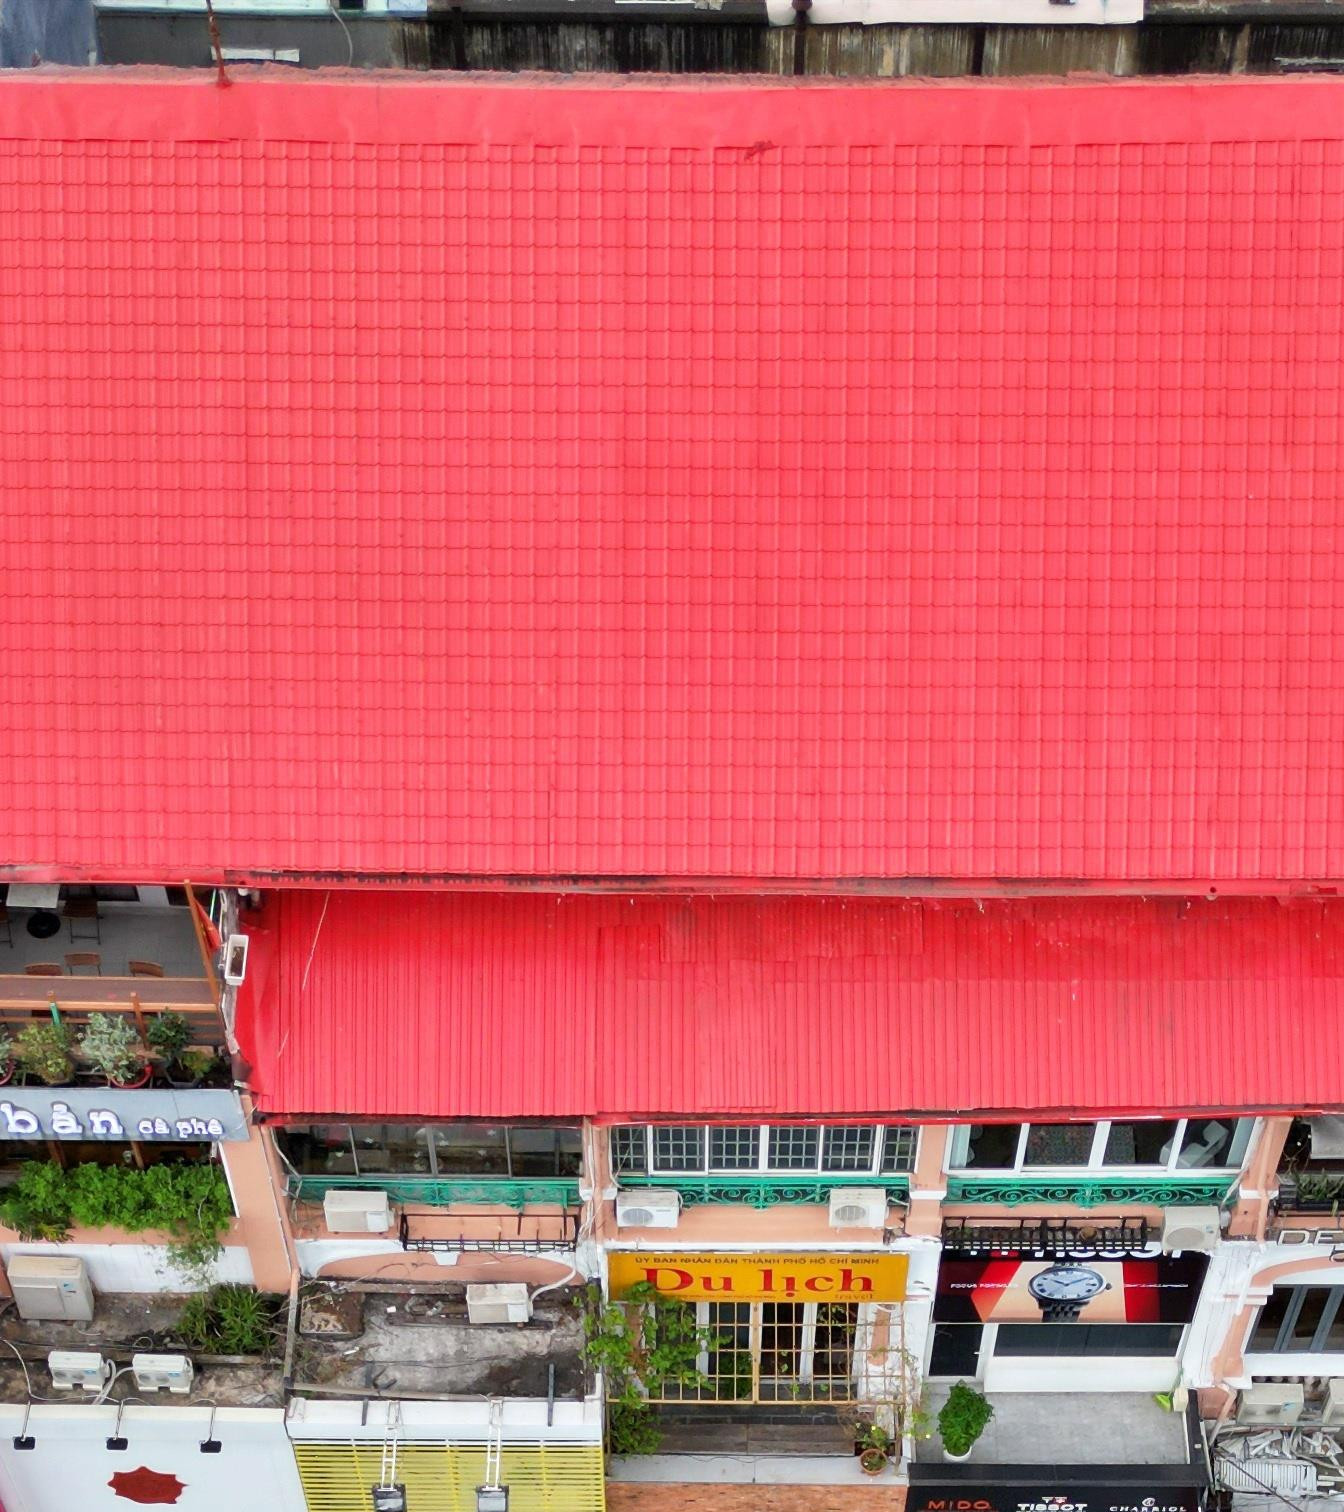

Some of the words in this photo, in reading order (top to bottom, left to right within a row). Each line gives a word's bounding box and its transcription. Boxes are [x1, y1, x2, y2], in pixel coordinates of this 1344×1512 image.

[640, 1267, 737, 1292] Du
[757, 1268, 876, 1298] lịch
[926, 1500, 992, 1510] MIDO
[1016, 1503, 1088, 1511] TISSOT
